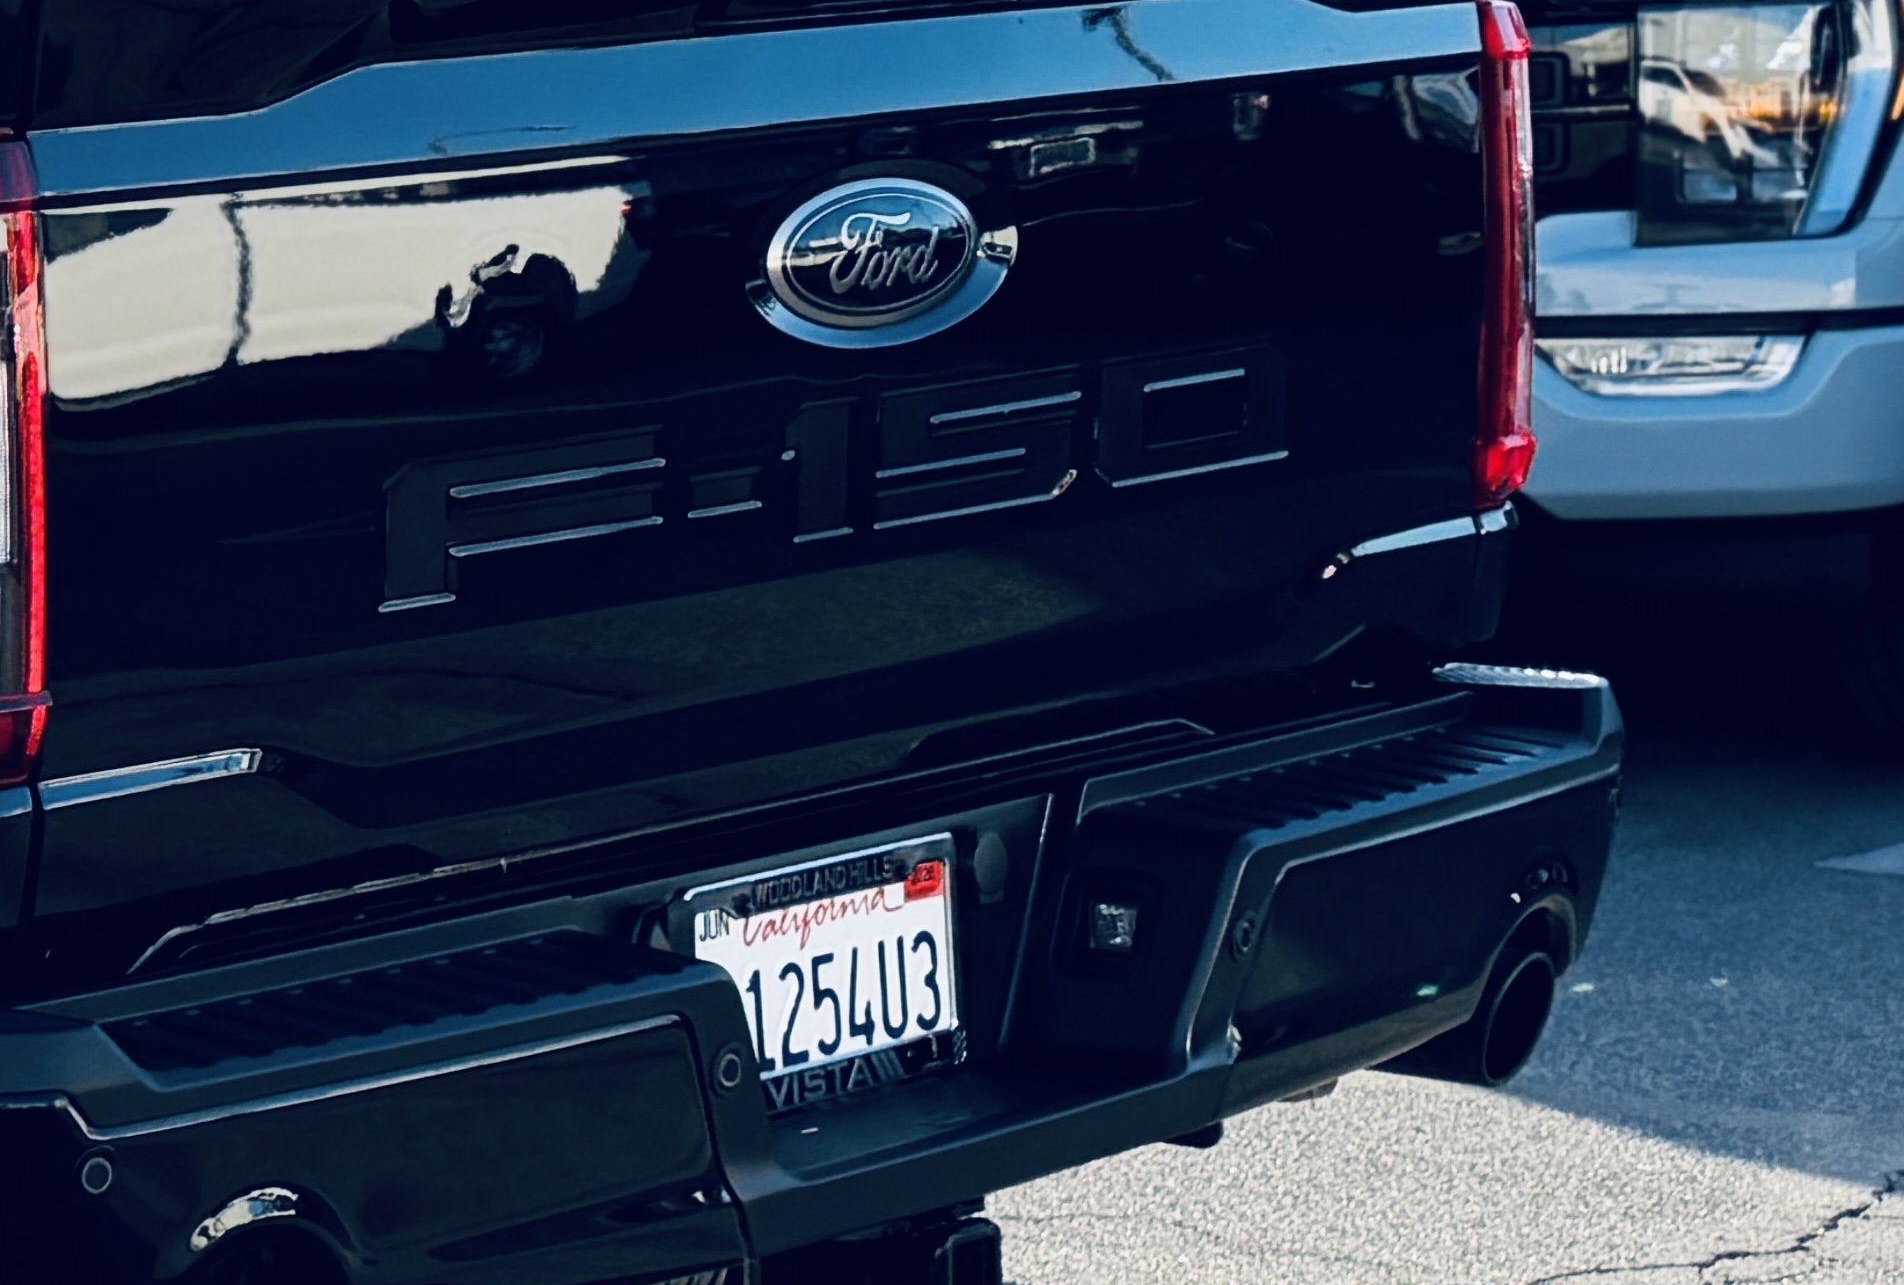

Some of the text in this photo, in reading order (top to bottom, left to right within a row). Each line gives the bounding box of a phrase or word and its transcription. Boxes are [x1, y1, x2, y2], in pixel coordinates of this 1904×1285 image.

[829, 212, 940, 294] Ford
[378, 343, 1289, 612] F-150
[754, 856, 893, 907] WOODLAND HILLS
[699, 908, 730, 942] JUN
[742, 886, 903, 950] California
[765, 1055, 875, 1111] VISTA
